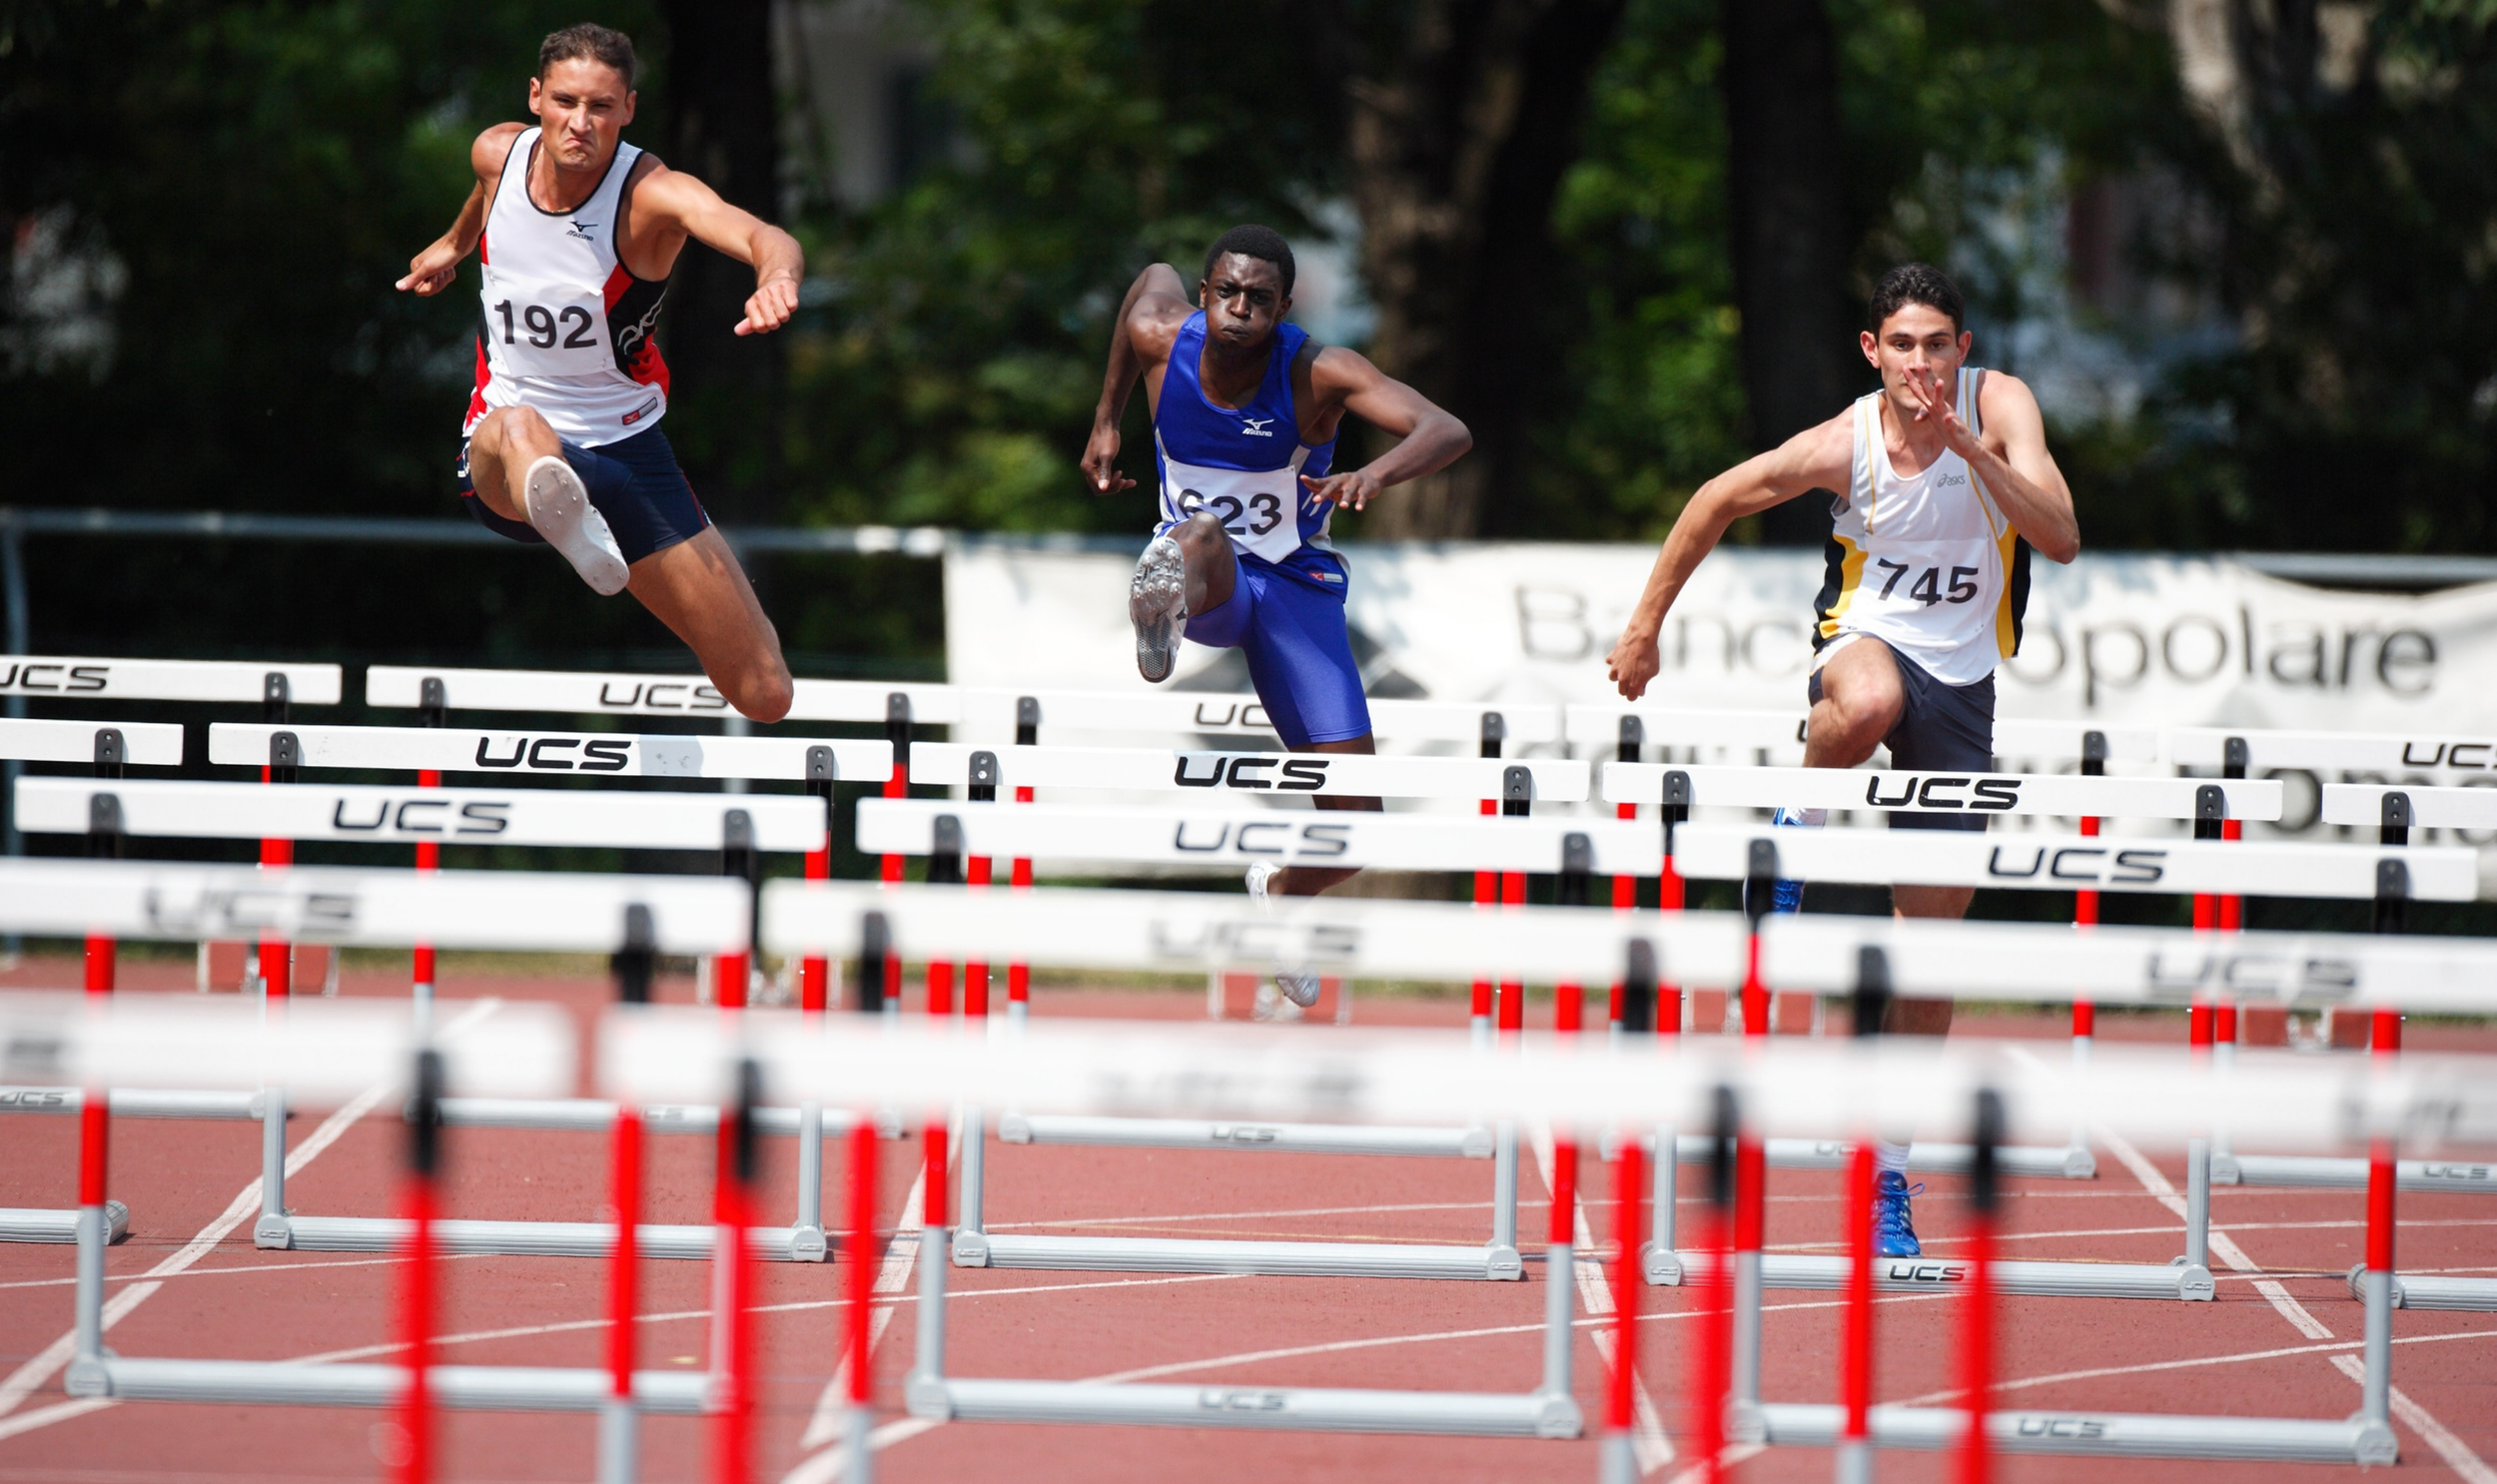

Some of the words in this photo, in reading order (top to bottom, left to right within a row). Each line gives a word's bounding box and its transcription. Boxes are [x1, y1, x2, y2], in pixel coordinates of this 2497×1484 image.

[494, 299, 597, 350] 192
[1877, 557, 1979, 607] 745
[2002, 601, 2438, 707] opolare
[599, 682, 729, 709] UCS
[1194, 702, 1276, 728] UC
[475, 737, 631, 771] UCS
[2402, 742, 2497, 768] UC
[1174, 756, 1329, 790] UCS
[1866, 776, 2022, 810] UCS
[334, 799, 511, 834] UCS
[1175, 821, 1351, 856] UCS
[1988, 846, 2167, 884] UCS
[1212, 1125, 1277, 1141] UCS
[2423, 1164, 2490, 1179] UCS
[1889, 1264, 1966, 1281] UCS
[1200, 1390, 1284, 1410] UCS
[2017, 1416, 2107, 1438] UCS
